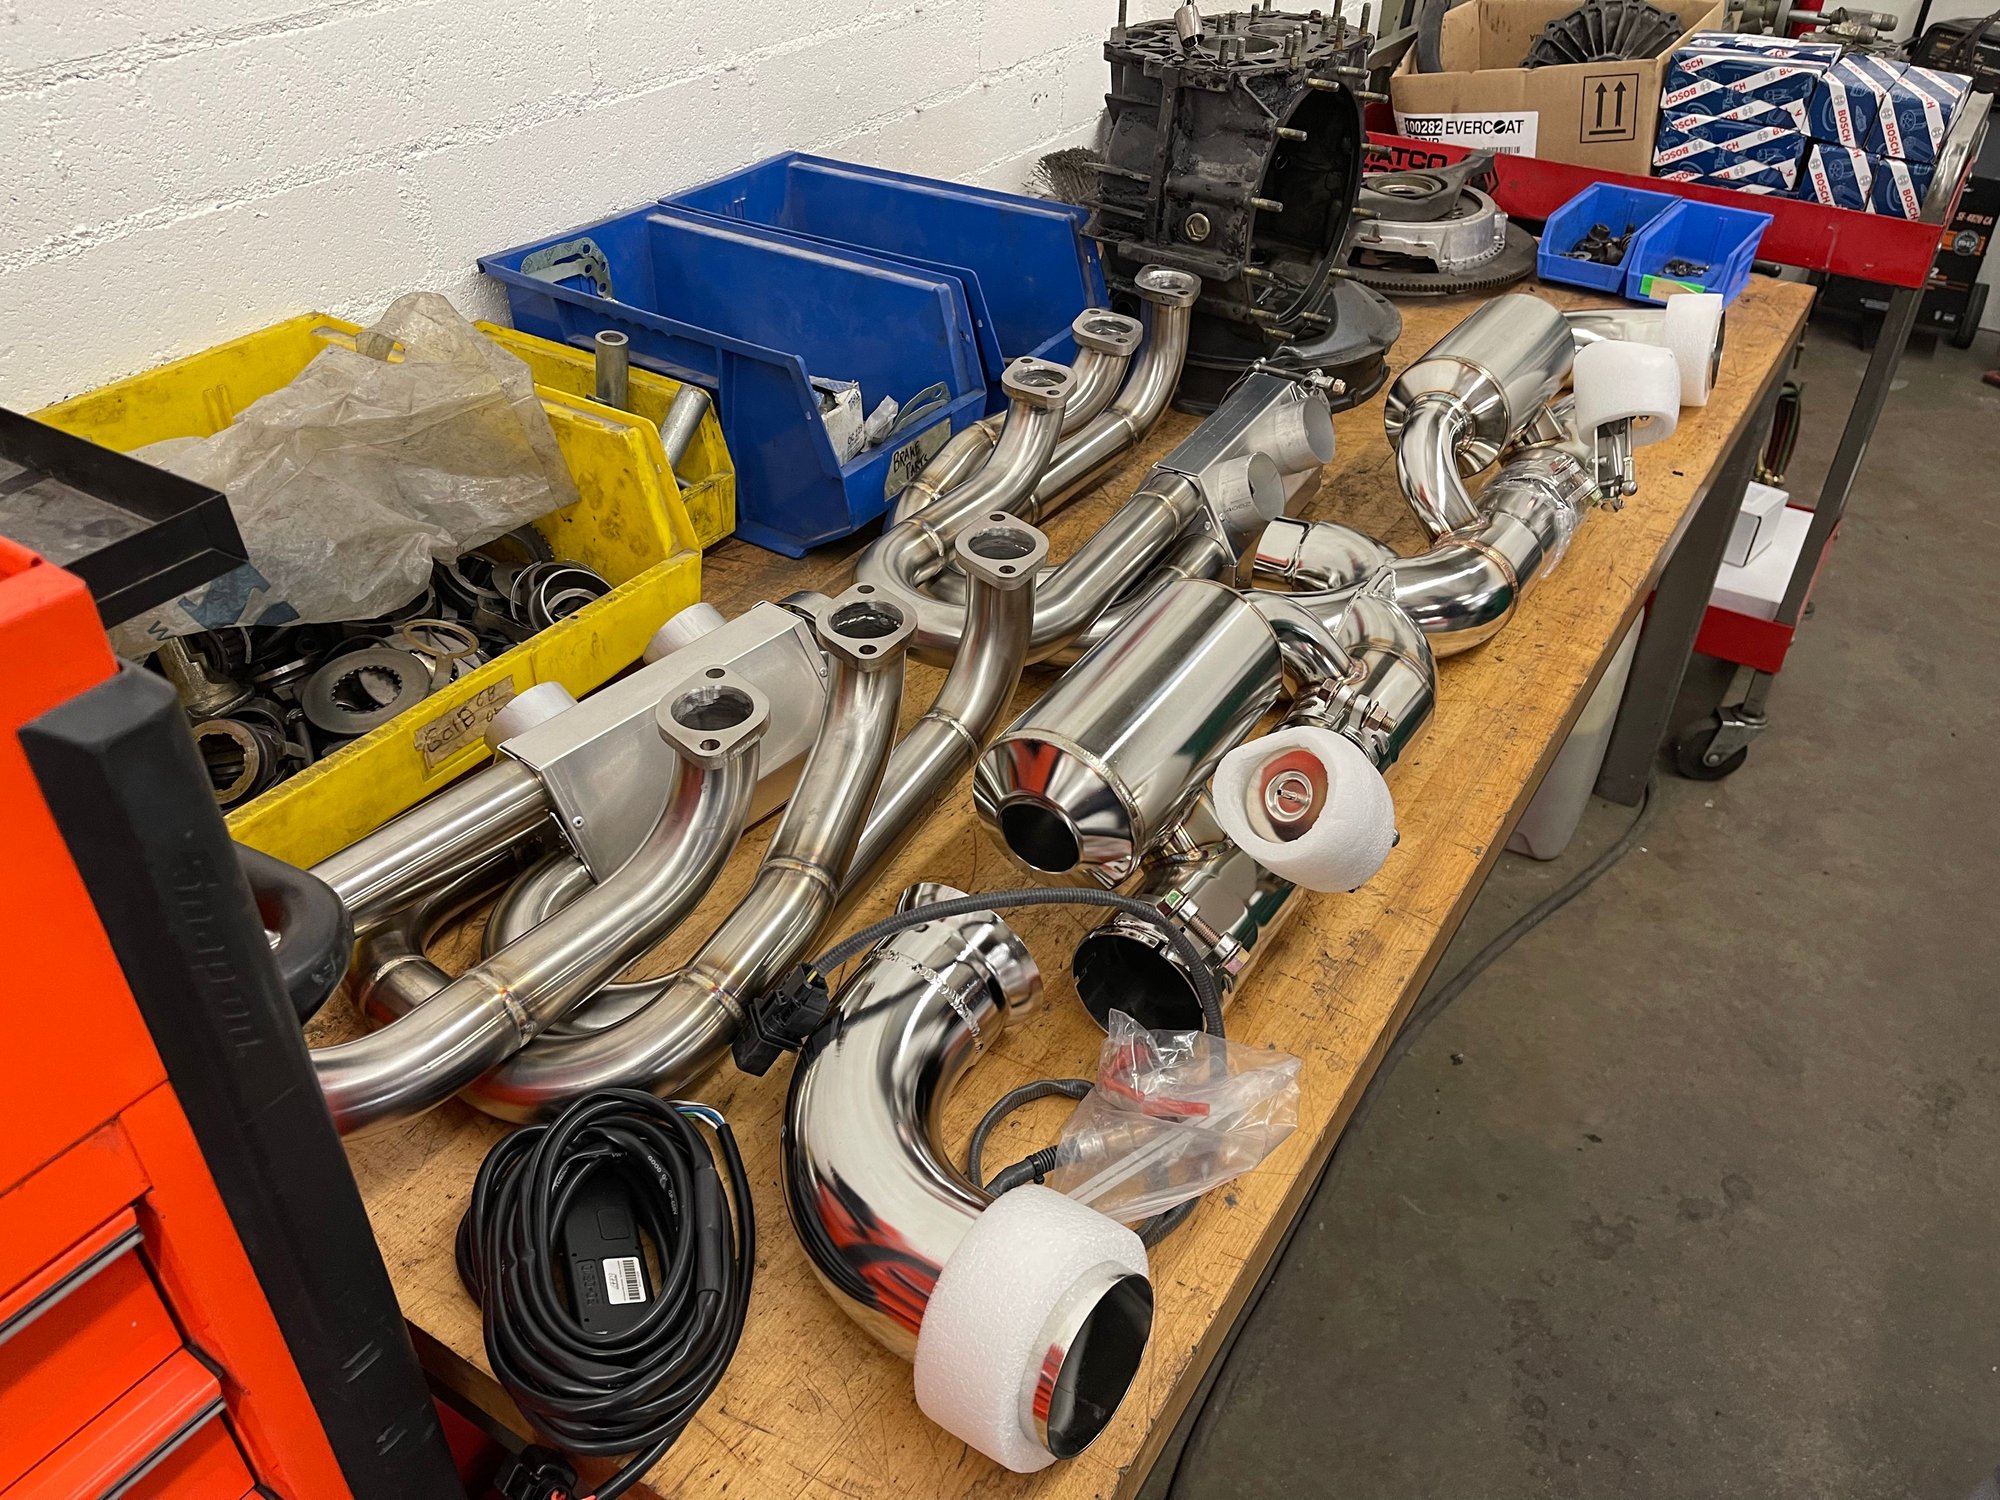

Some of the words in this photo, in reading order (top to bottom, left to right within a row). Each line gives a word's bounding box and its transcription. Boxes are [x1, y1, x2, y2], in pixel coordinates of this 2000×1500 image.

[1680, 57, 1704, 71] OSCH
[1665, 87, 1697, 105] BOSCH
[1405, 119, 1443, 135] 100282
[1445, 119, 1525, 135] EVERCOAT
[1674, 116, 1697, 129] OSCH
[1837, 109, 1851, 142] BOSCH
[1885, 122, 1901, 155] BOSCH
[1364, 147, 1448, 170] ATCO
[1658, 146, 1689, 163] BOSCH
[1814, 172, 1831, 203] BOSCH
[1902, 188, 1919, 221] BOSCH
[893, 440, 921, 473] BRAKE
